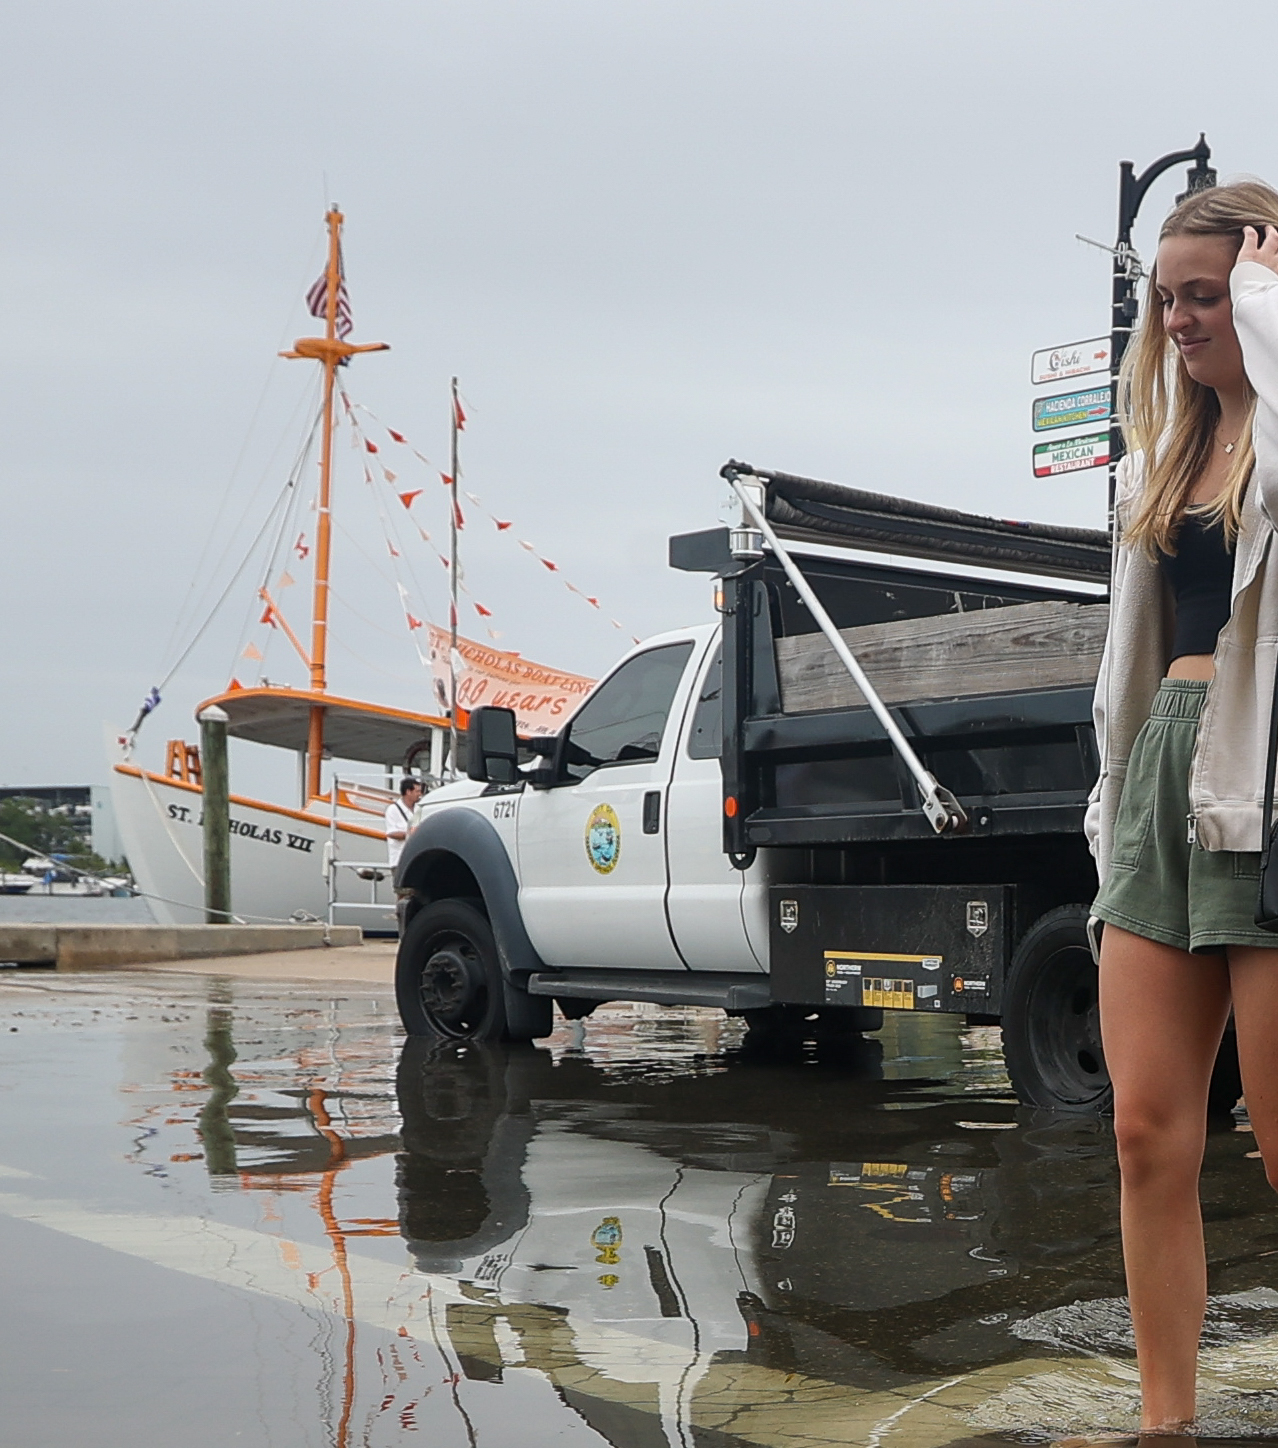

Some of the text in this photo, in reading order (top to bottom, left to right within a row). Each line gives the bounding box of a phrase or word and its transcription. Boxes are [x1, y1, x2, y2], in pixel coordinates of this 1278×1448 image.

[1046, 397, 1076, 413] HACIENDA
[1052, 446, 1094, 462] MEXICAN
[1050, 457, 1095, 474] RESTAURANT
[522, 667, 561, 686] BOAT
[491, 690, 569, 716] years
[493, 800, 517, 819] 6721
[168, 803, 193, 824] ST.
[287, 833, 315, 853] VII
